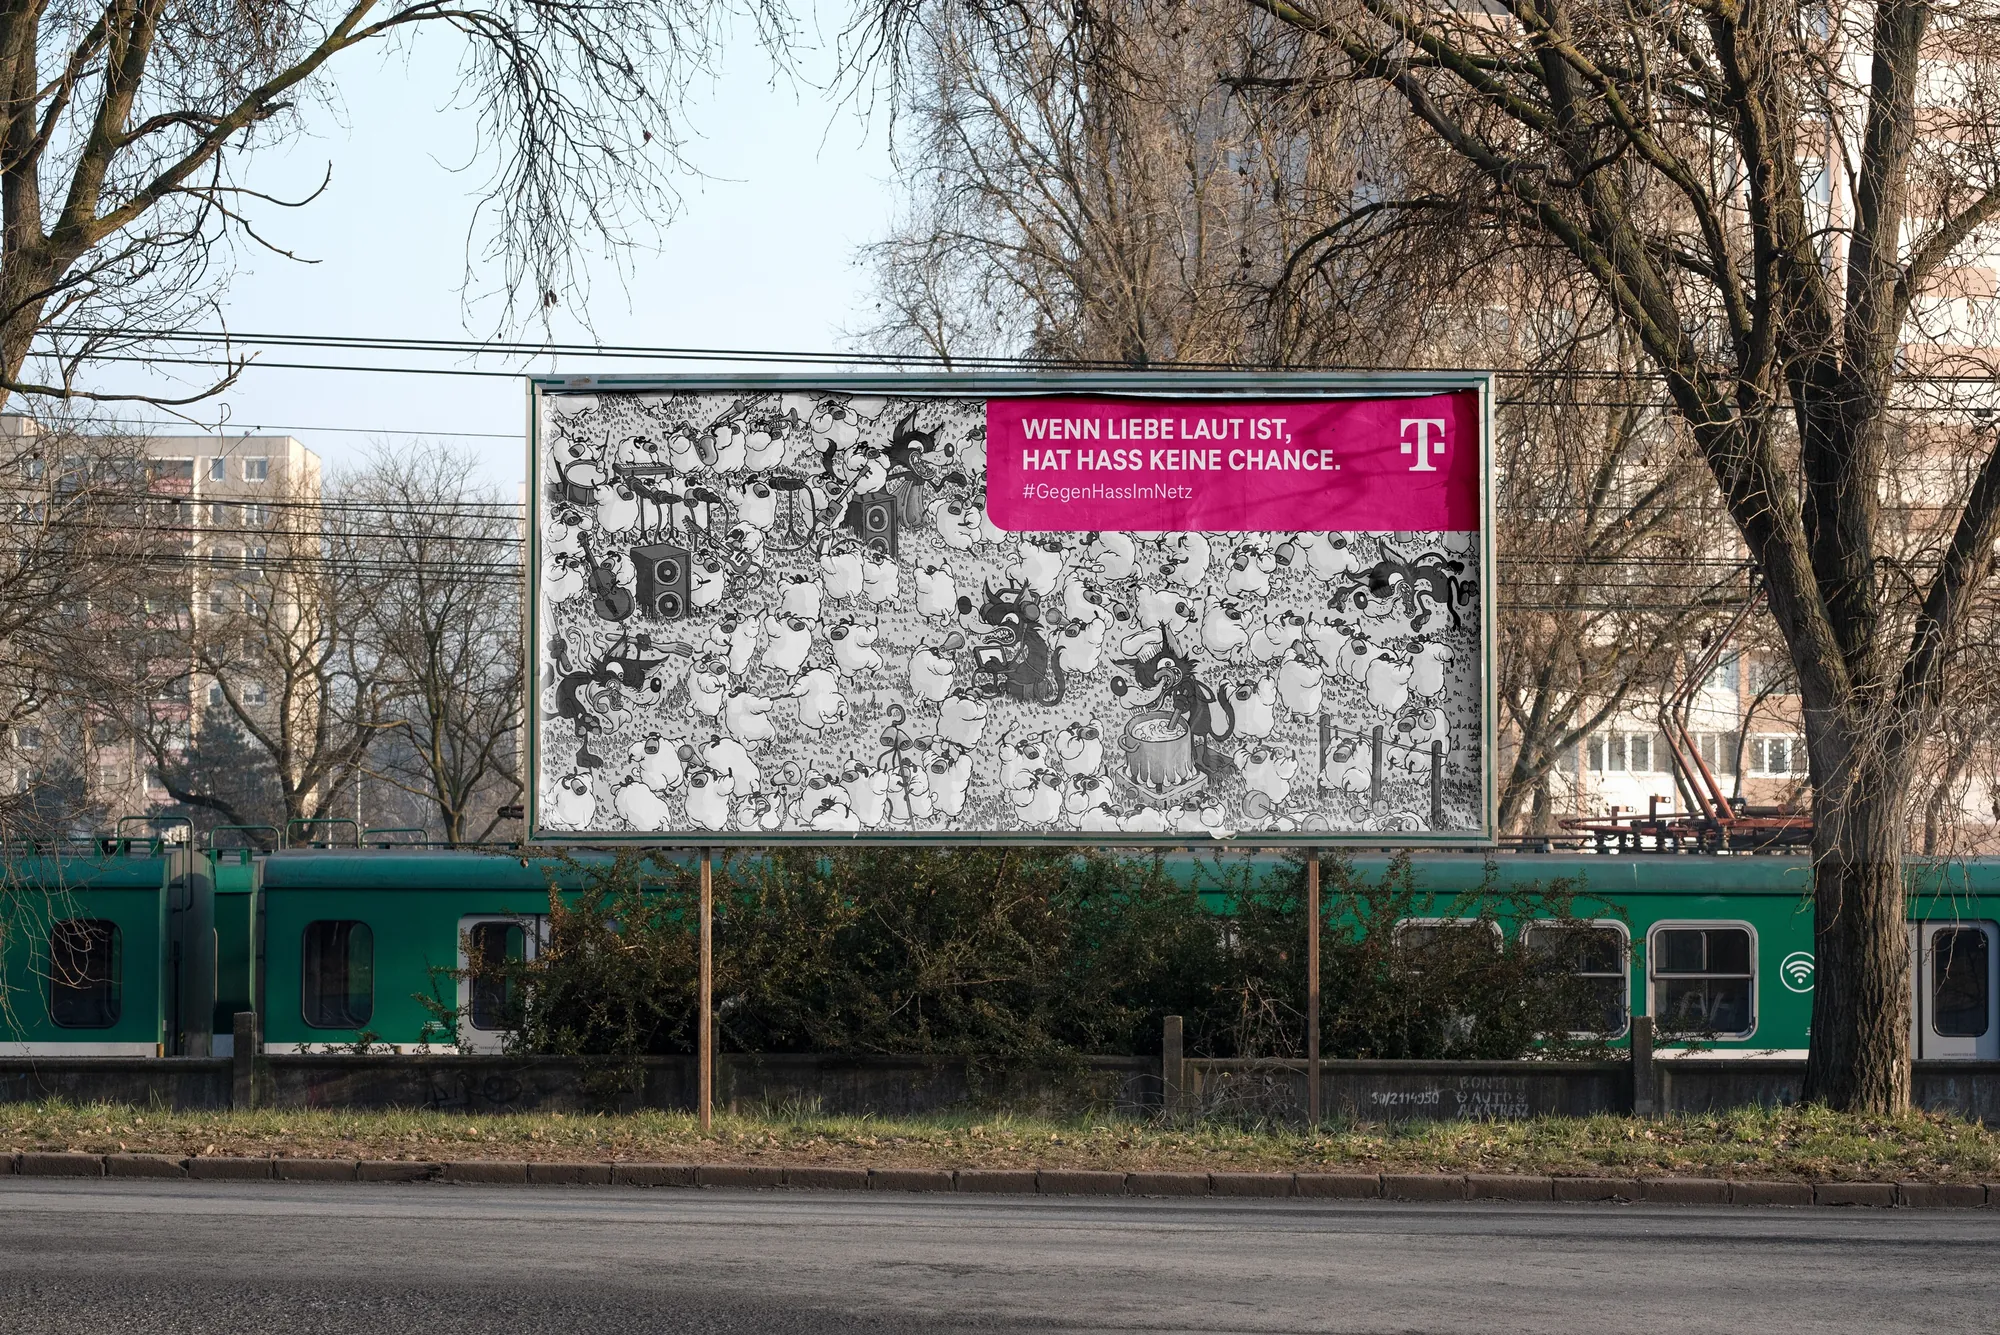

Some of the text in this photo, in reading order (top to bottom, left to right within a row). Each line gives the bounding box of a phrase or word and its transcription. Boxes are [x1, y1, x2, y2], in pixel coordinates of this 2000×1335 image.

[1022, 418, 1292, 445] WENN LIEBE LAUT IST,
[1400, 418, 1445, 472] T
[1022, 448, 1341, 471] HAT HASS KEINE CHANCE.
[1022, 483, 1193, 503] #GegenHassImNetz
